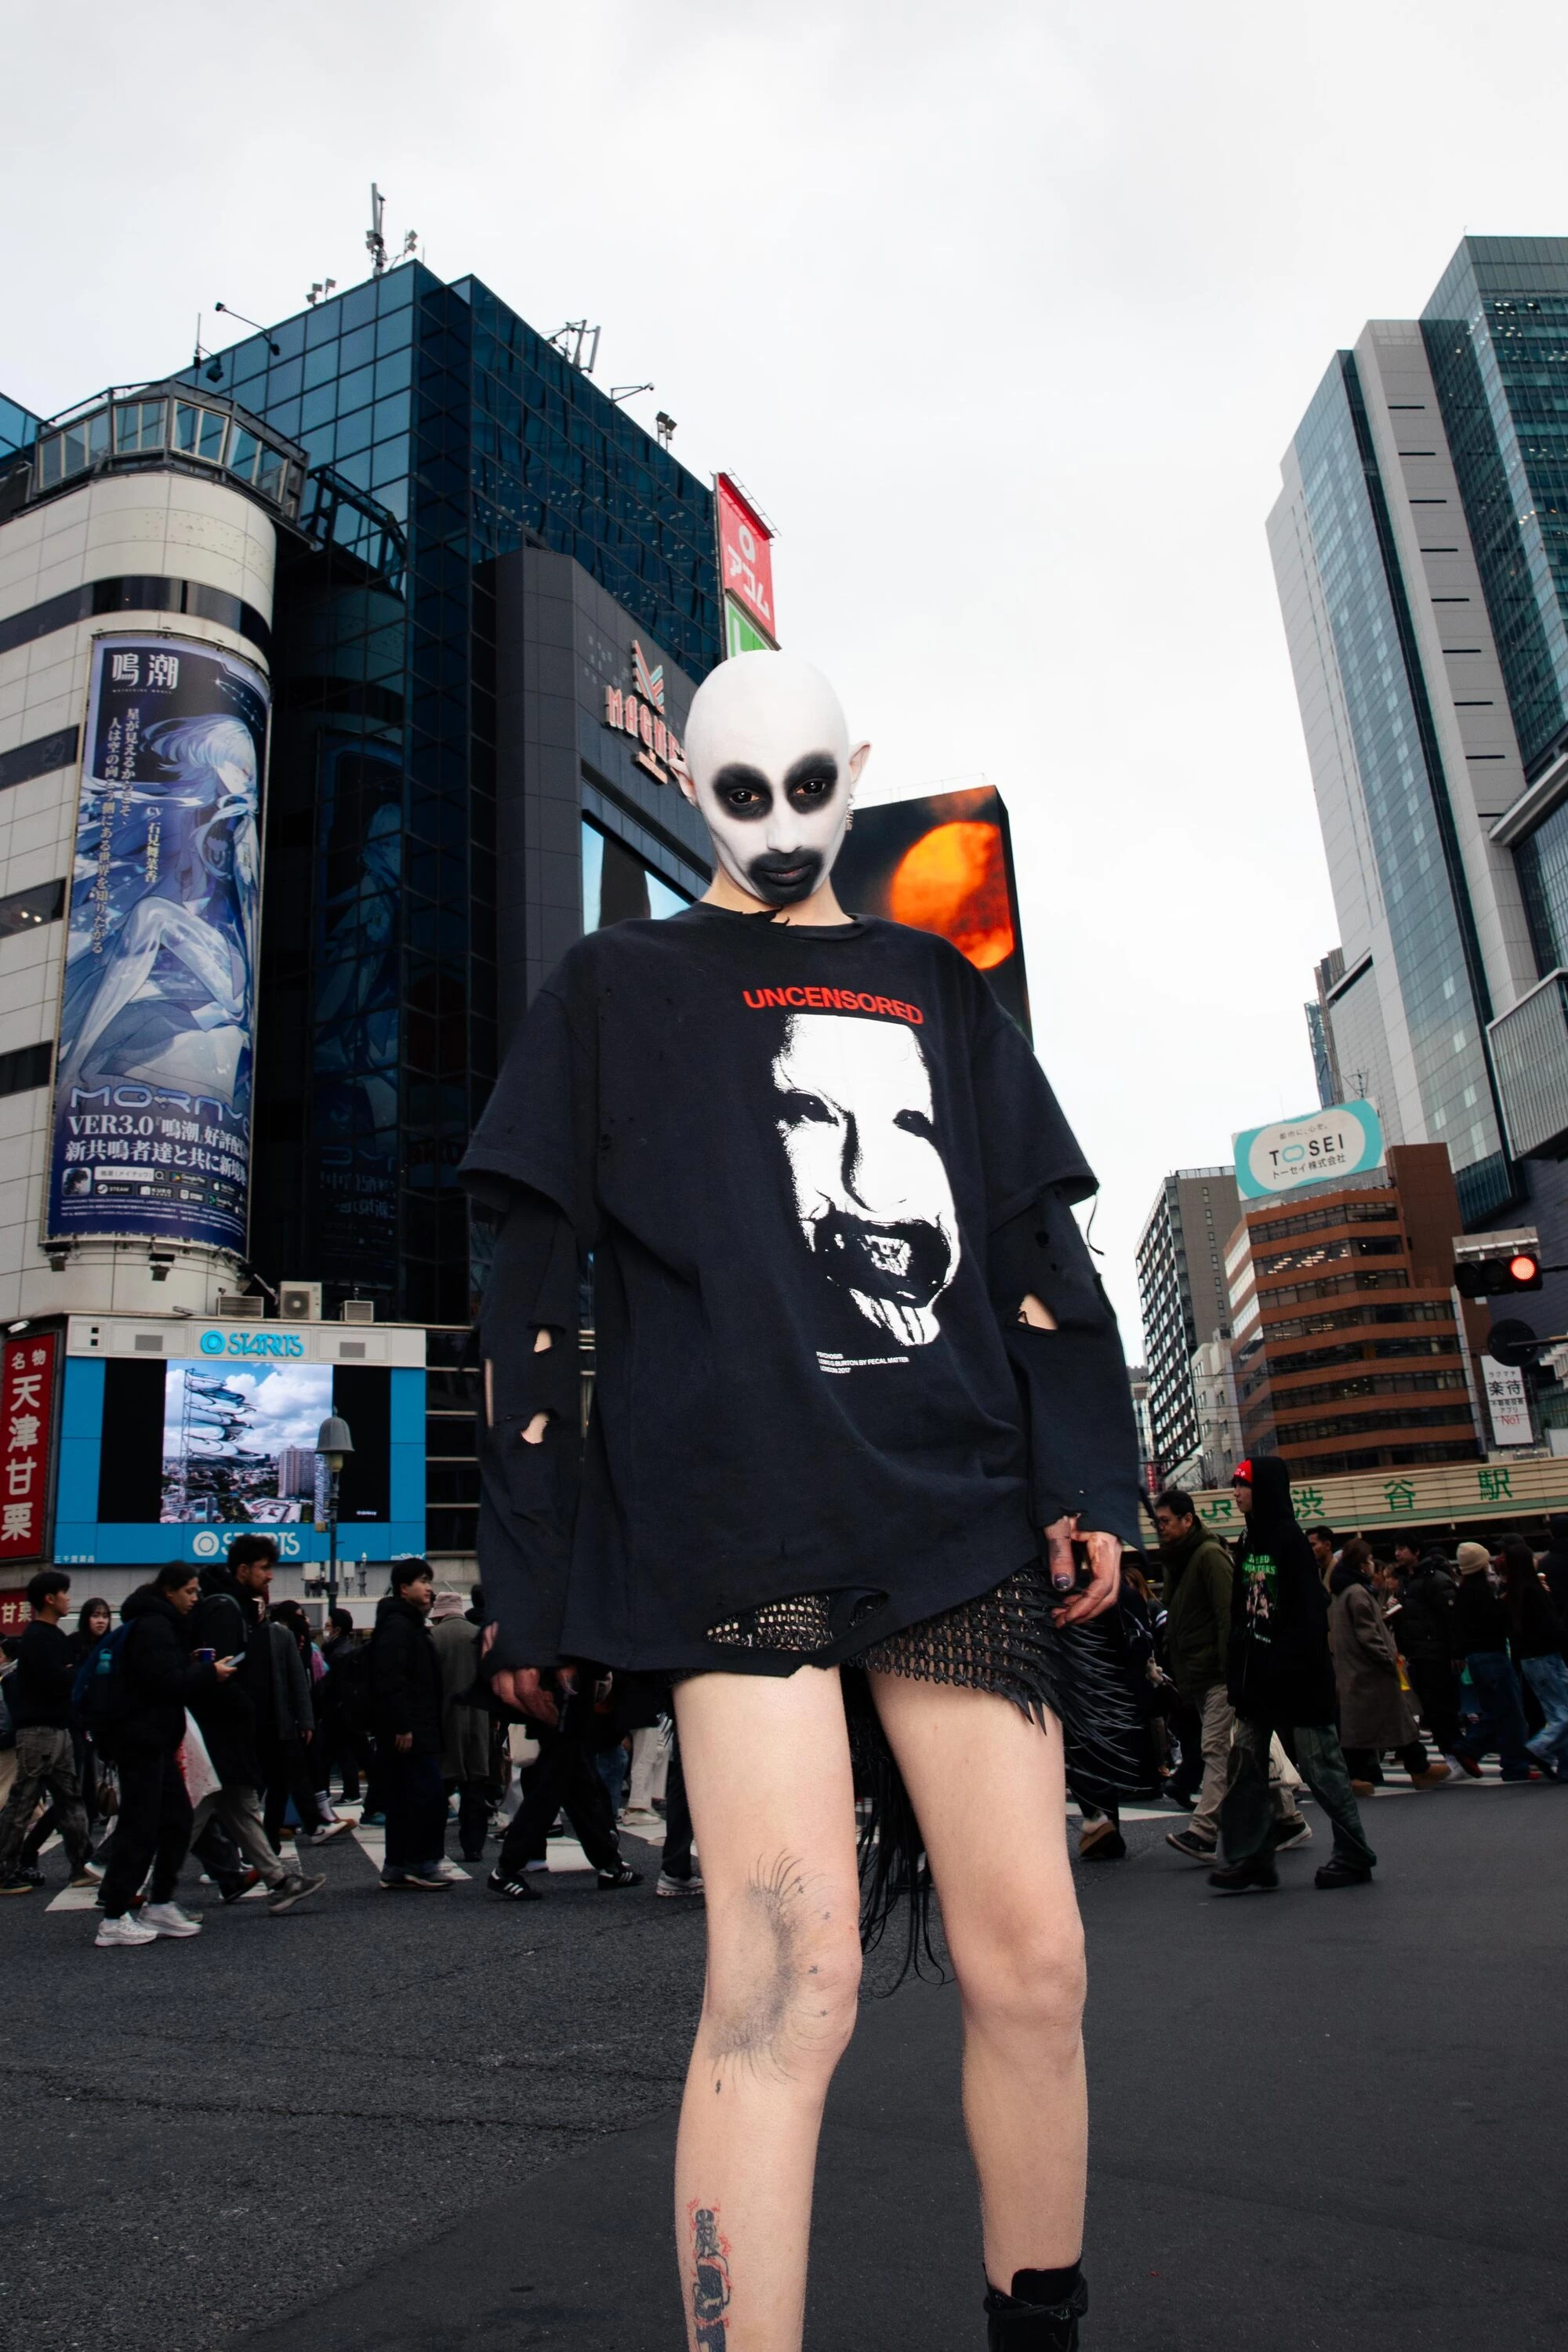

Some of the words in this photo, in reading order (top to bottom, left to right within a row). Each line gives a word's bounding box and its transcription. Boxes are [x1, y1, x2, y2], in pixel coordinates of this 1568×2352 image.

[112, 653, 180, 689] 鳴潮
[742, 987, 924, 1025] UNCENSORED
[1269, 1134, 1344, 1166] TOSEI
[11, 1349, 47, 1370] 名物
[227, 1332, 304, 1357] STARTS
[1490, 1381, 1521, 1396] 楽待
[1, 1374, 42, 1541] 天津甘栗
[1200, 1499, 1233, 1519] JR
[1292, 1468, 1513, 1519] 渋谷駅
[2, 1601, 32, 1624] 甘栗
